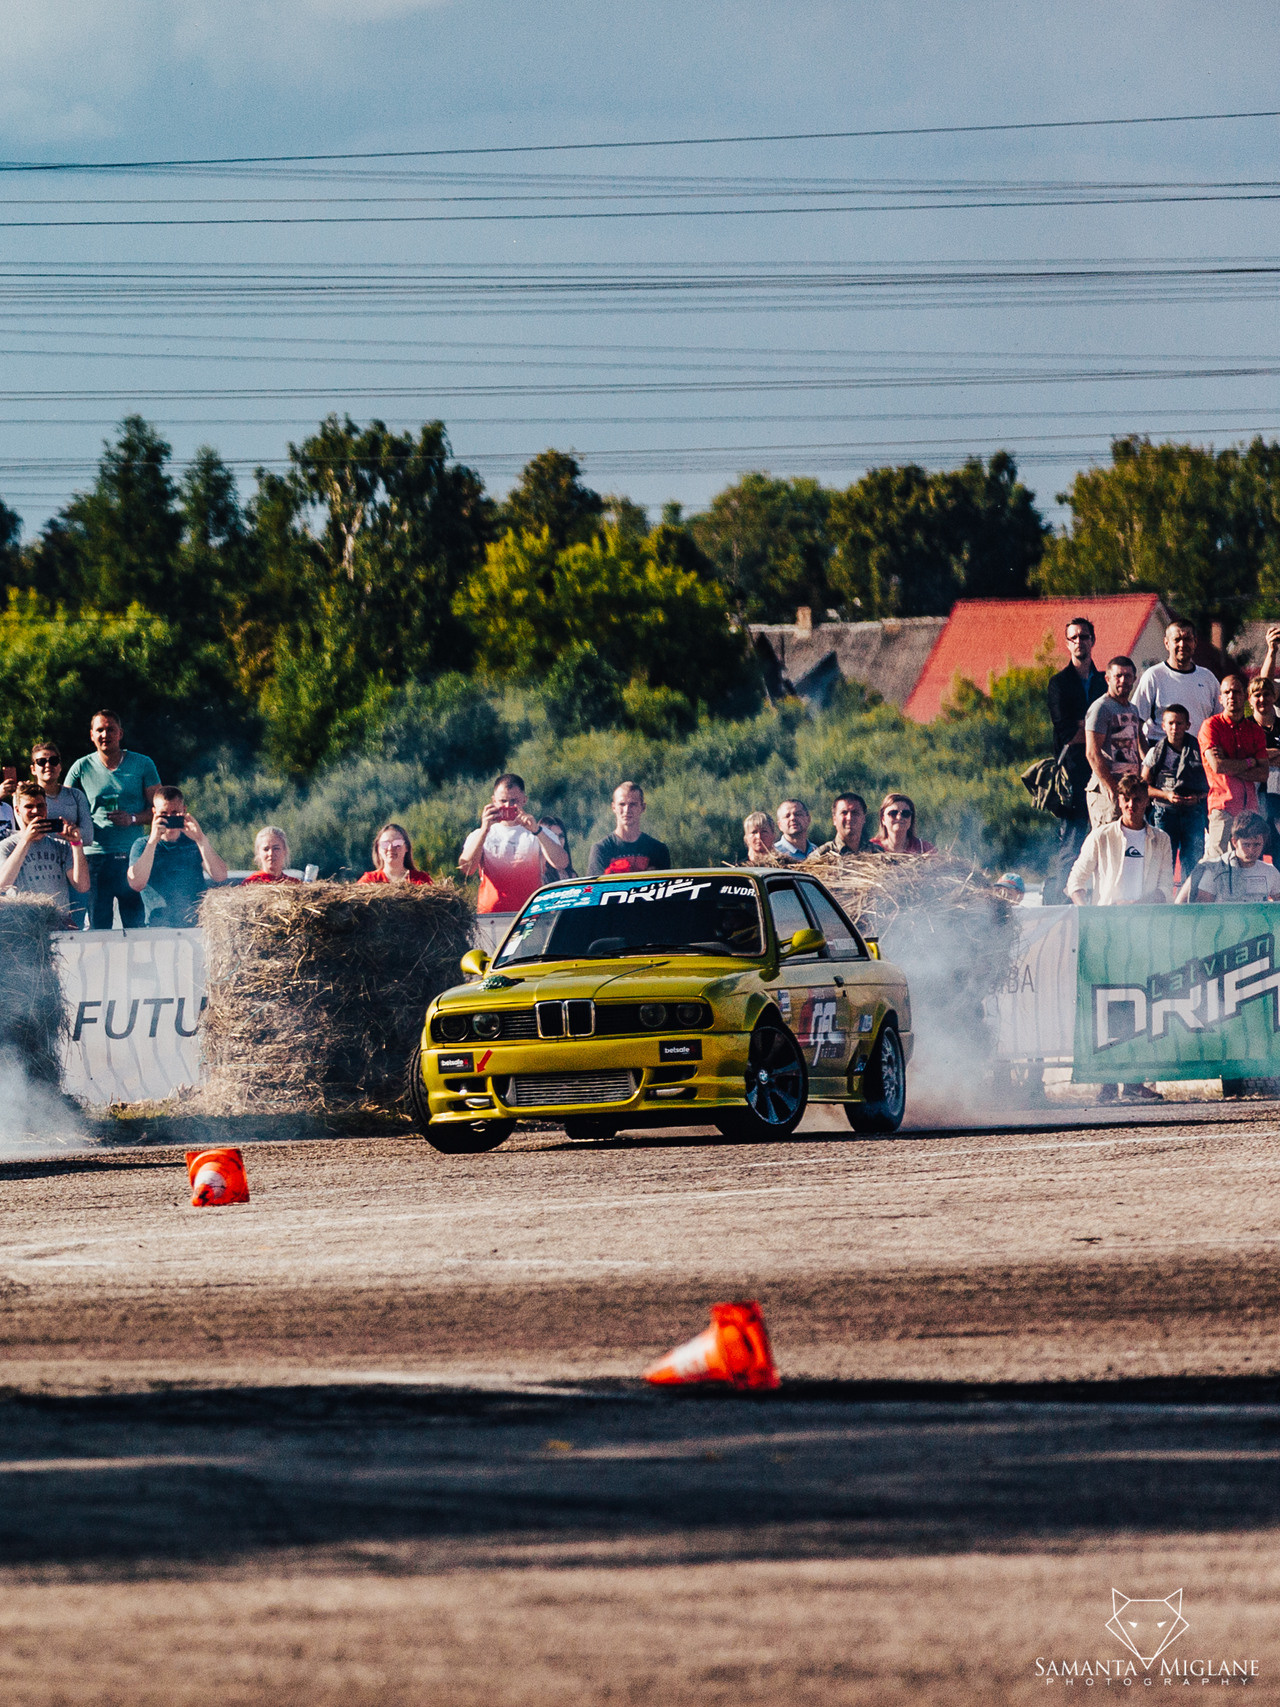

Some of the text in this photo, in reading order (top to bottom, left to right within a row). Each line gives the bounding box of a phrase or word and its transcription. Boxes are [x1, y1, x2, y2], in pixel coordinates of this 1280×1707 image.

[600, 882, 711, 905] DRIFT
[1151, 938, 1270, 999] Latvian
[72, 996, 209, 1041] FUTU
